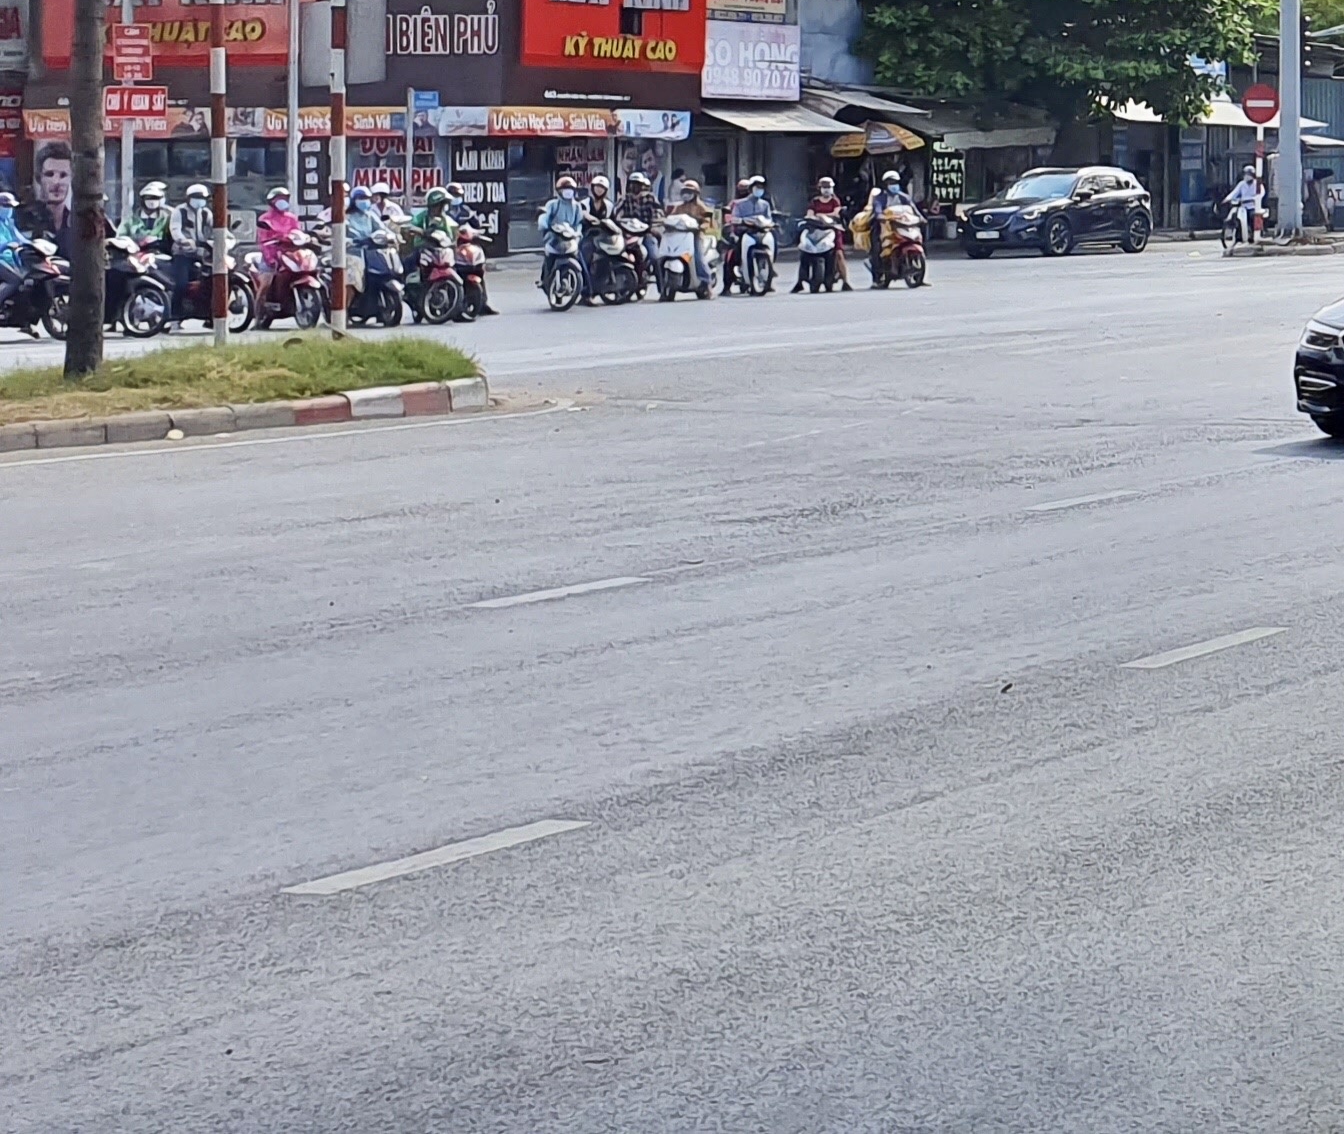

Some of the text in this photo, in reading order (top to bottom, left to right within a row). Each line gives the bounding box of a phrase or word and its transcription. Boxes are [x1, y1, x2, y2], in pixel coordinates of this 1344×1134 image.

[397, 5, 450, 55] BIÊN
[454, 0, 499, 55] PHỦ
[646, 39, 677, 62] CAO
